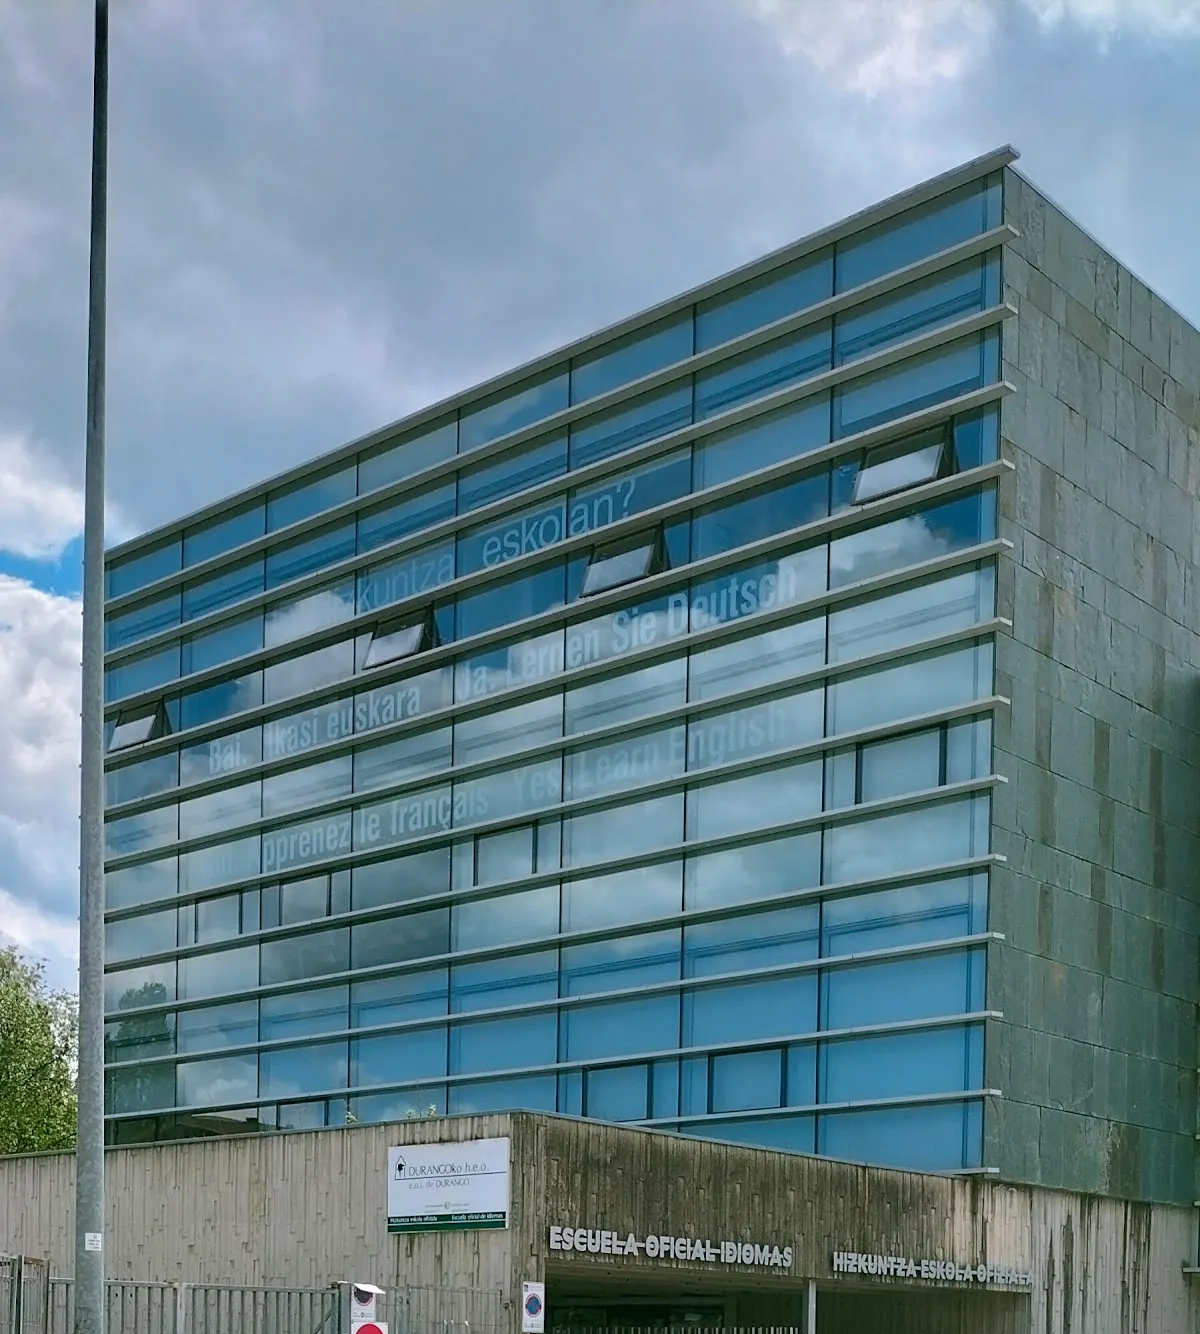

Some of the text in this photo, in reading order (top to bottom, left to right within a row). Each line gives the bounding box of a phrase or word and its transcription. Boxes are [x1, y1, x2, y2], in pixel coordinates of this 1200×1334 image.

[482, 476, 636, 568] eskolan?
[505, 624, 601, 685] Lernen
[612, 606, 657, 653] Sie
[666, 560, 797, 637] Deutsch
[265, 710, 318, 758] Ikasi
[326, 684, 421, 740] euskara
[578, 740, 659, 791] Learn
[668, 706, 786, 767] English
[359, 806, 381, 844] le
[391, 786, 489, 836] français
[408, 1163, 462, 1177] DURANGOko
[435, 1178, 470, 1188] DURANGO
[549, 1226, 793, 1268] ESCUELA OFICIAL IDIOMAS
[833, 1251, 1036, 1286] HIZKUNTZA ESKOLA OFIZIALA
